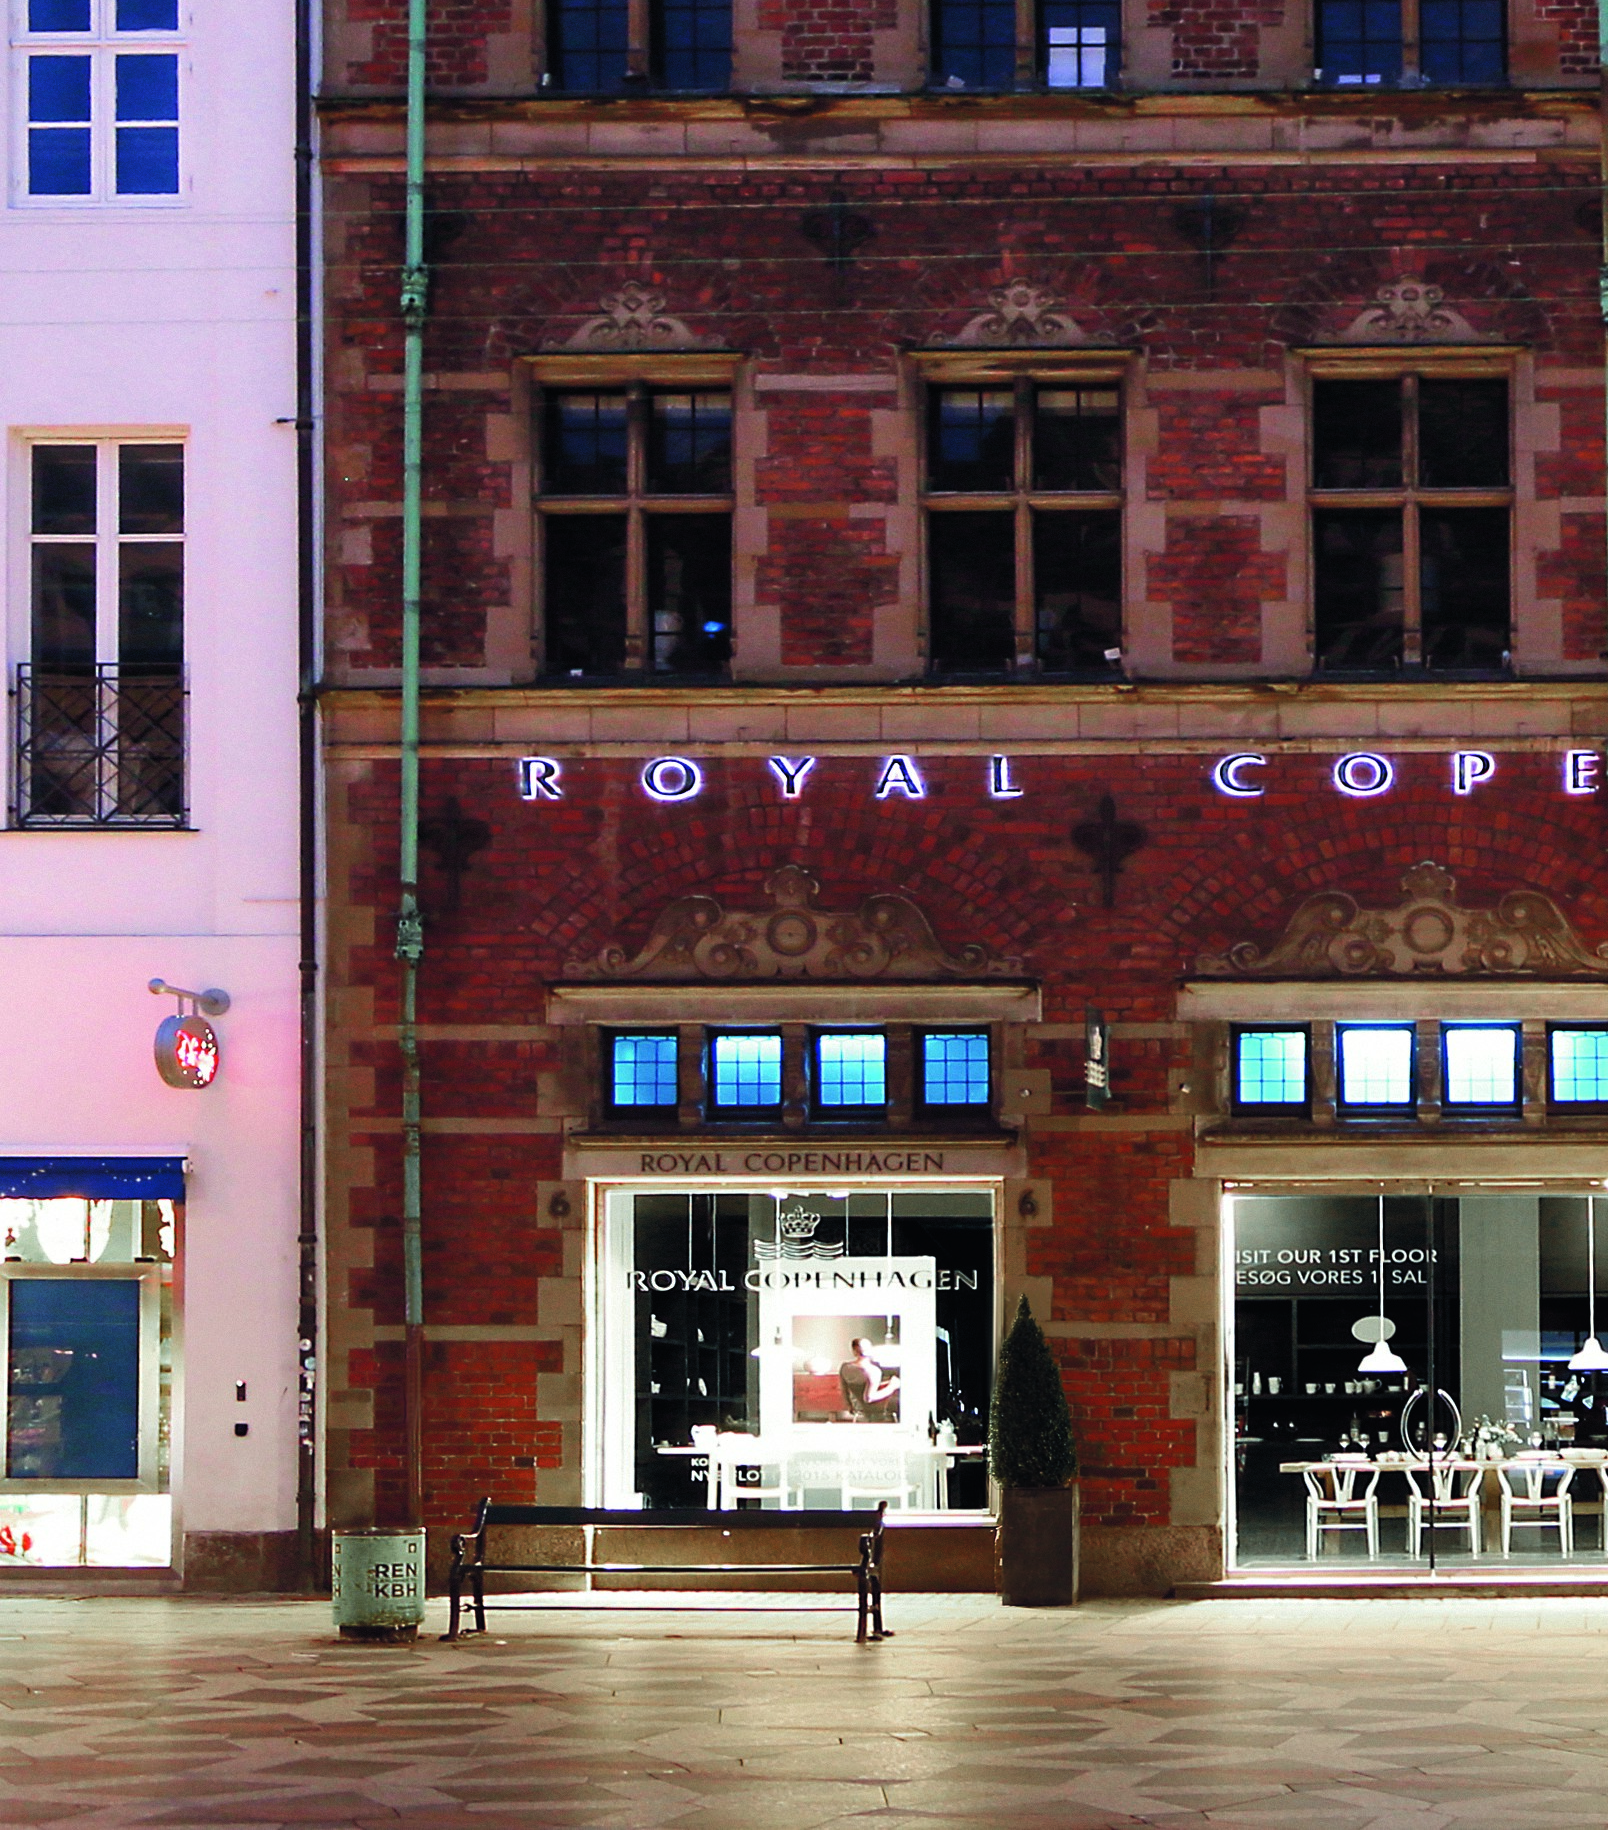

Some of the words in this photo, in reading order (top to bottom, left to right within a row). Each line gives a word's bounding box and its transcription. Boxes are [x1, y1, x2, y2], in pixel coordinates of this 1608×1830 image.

[519, 754, 1025, 800] ROYAL
[640, 1153, 728, 1172] ROYAL
[743, 1152, 945, 1172] COPENHAGEN
[549, 1189, 571, 1218] 6
[1018, 1188, 1037, 1217] 6
[1236, 1249, 1271, 1264] ISIT
[1277, 1249, 1321, 1264] OUR
[1329, 1249, 1362, 1264] 1ST
[1369, 1249, 1438, 1263] FLOOR
[627, 1269, 736, 1292] ROYAL
[743, 1269, 979, 1291] COPENHAGEN
[1236, 1269, 1291, 1285] ESØG
[1297, 1269, 1363, 1285] VORES
[1392, 1270, 1428, 1284] SAL
[375, 1562, 417, 1578] REN
[375, 1582, 417, 1599] KBH
